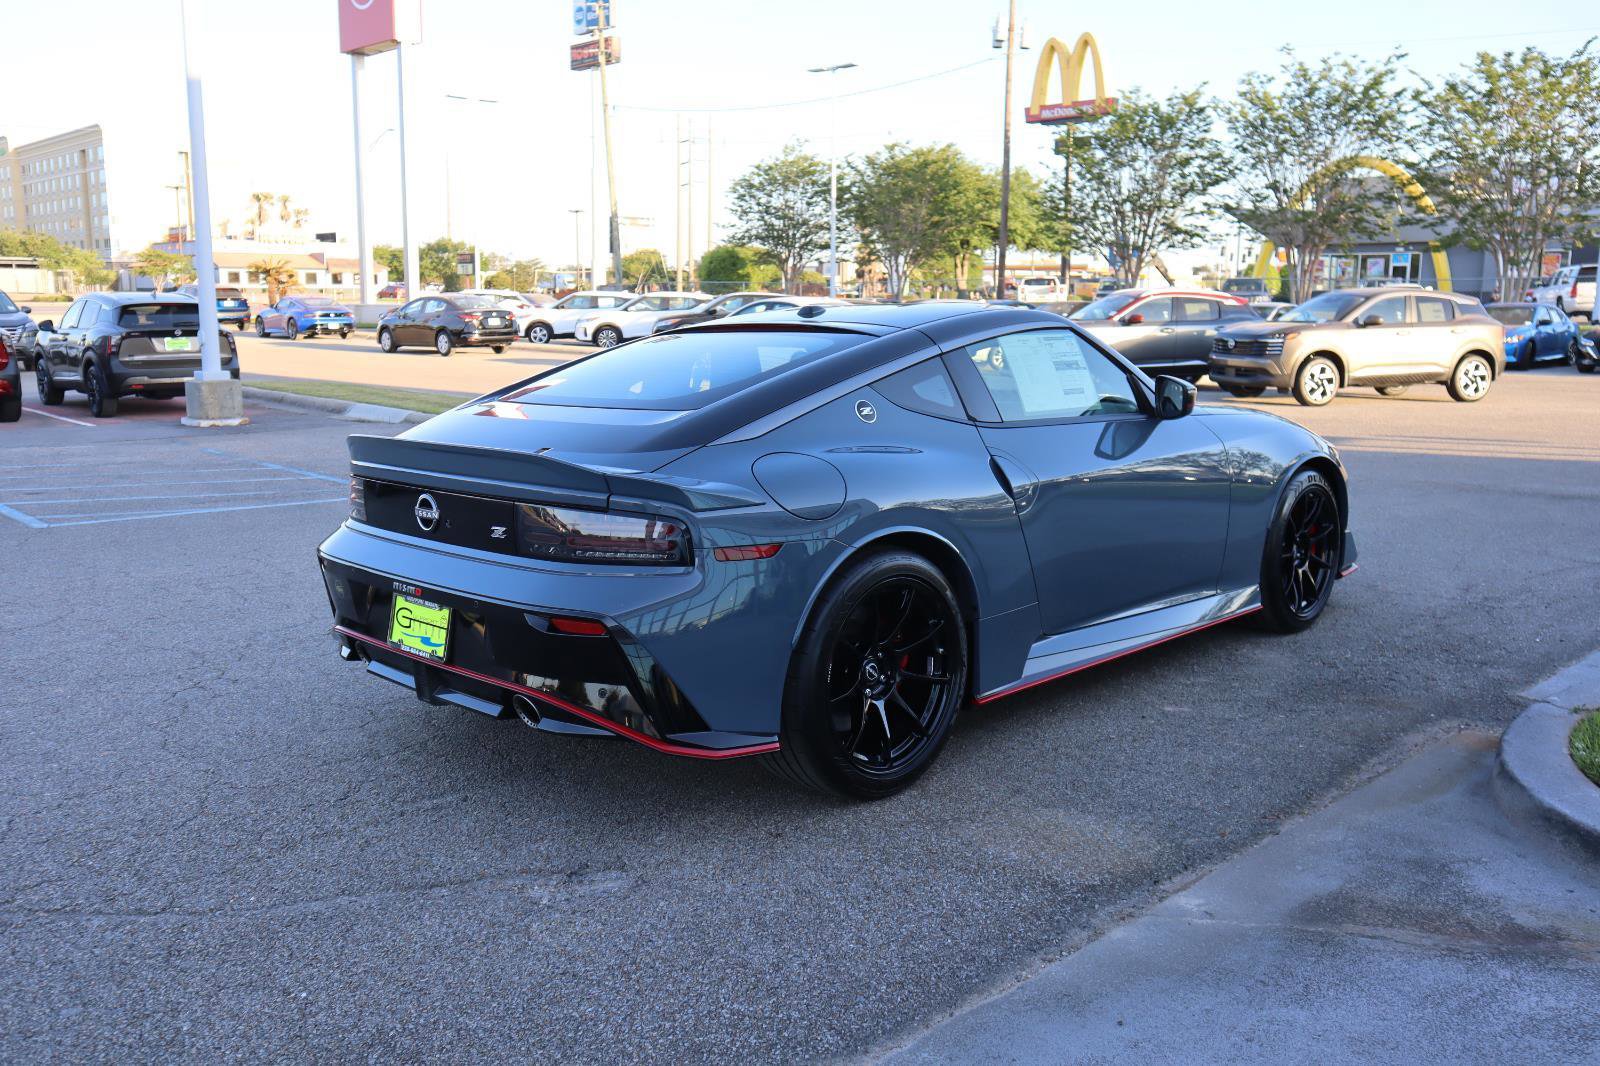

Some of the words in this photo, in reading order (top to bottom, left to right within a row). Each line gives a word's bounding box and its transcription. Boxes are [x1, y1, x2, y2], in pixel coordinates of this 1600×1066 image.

[1041, 104, 1093, 118] McDona's
[415, 507, 439, 519] SSAN
[491, 526, 507, 538] Z
